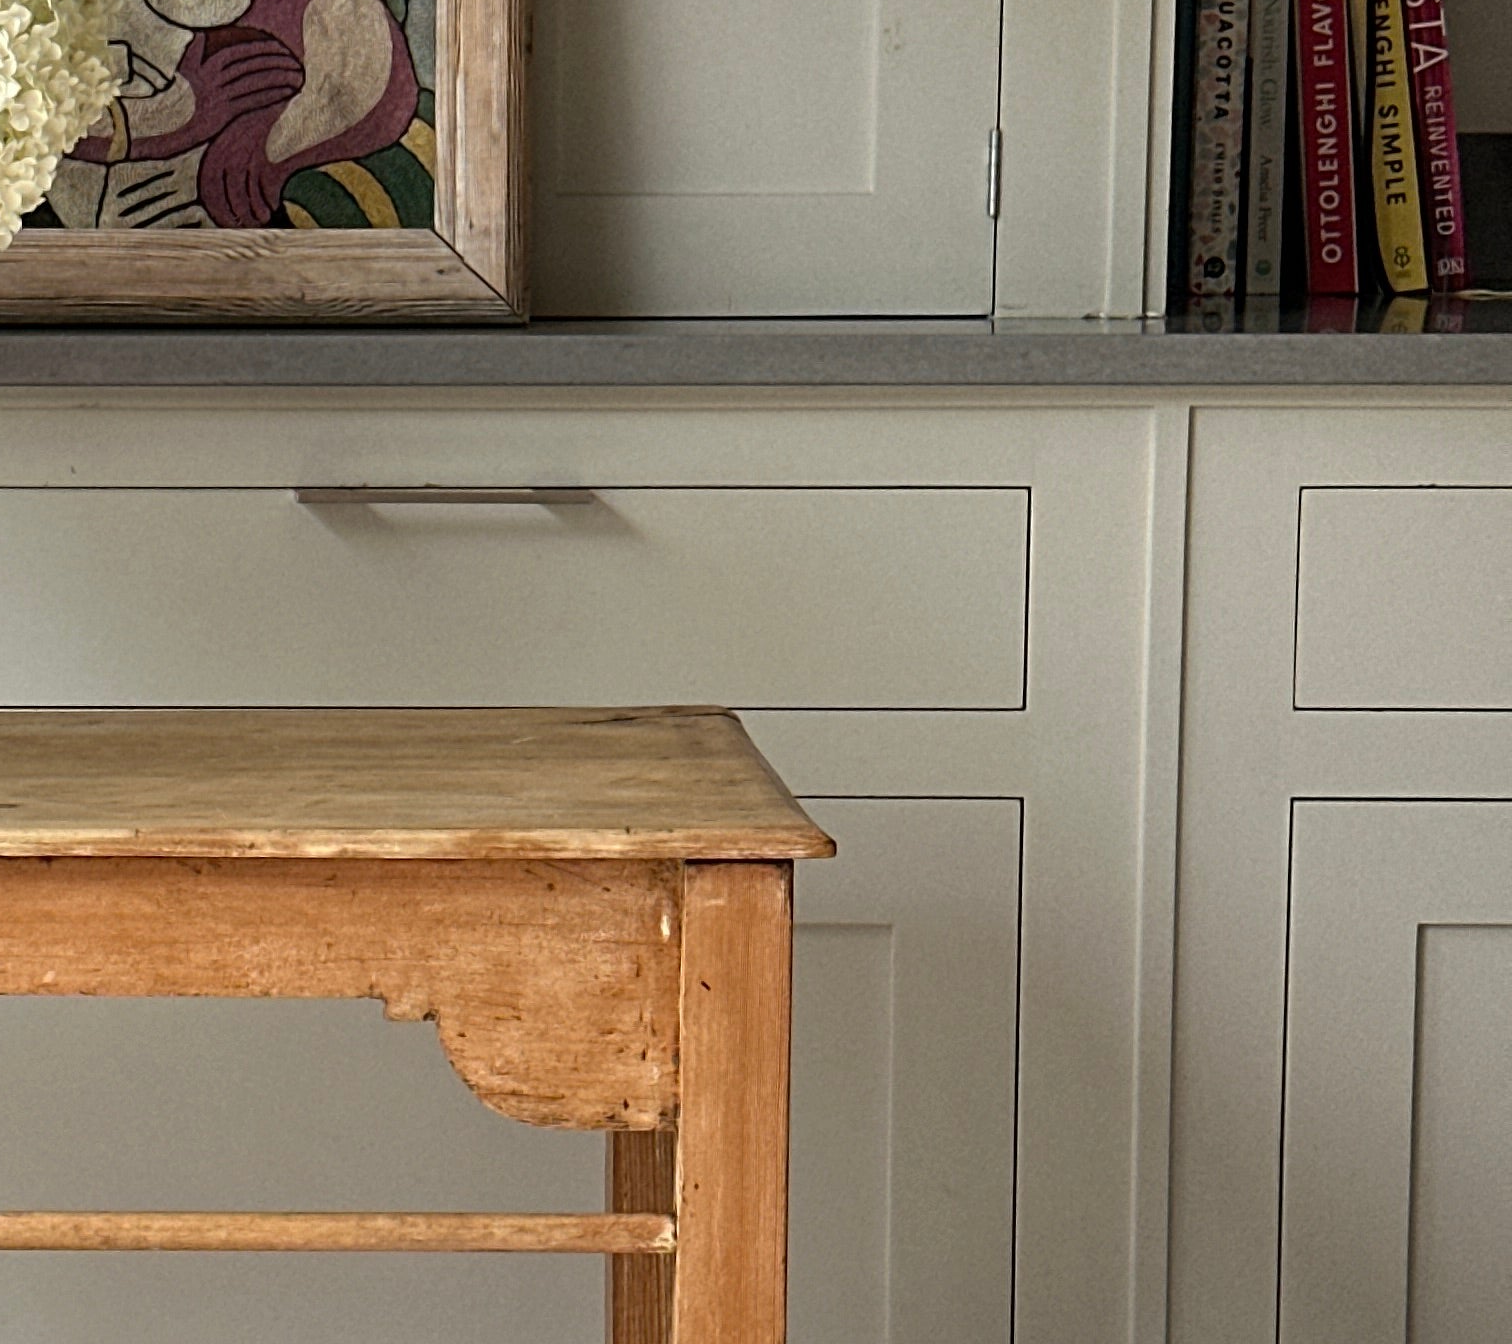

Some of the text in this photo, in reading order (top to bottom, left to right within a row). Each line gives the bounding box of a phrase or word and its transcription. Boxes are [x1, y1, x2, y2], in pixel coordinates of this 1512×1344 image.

[1316, 82, 1343, 264] OTTOLENGHI
[1378, 104, 1408, 206] SIMPLE
[1423, 85, 1455, 236] REINVENTED
